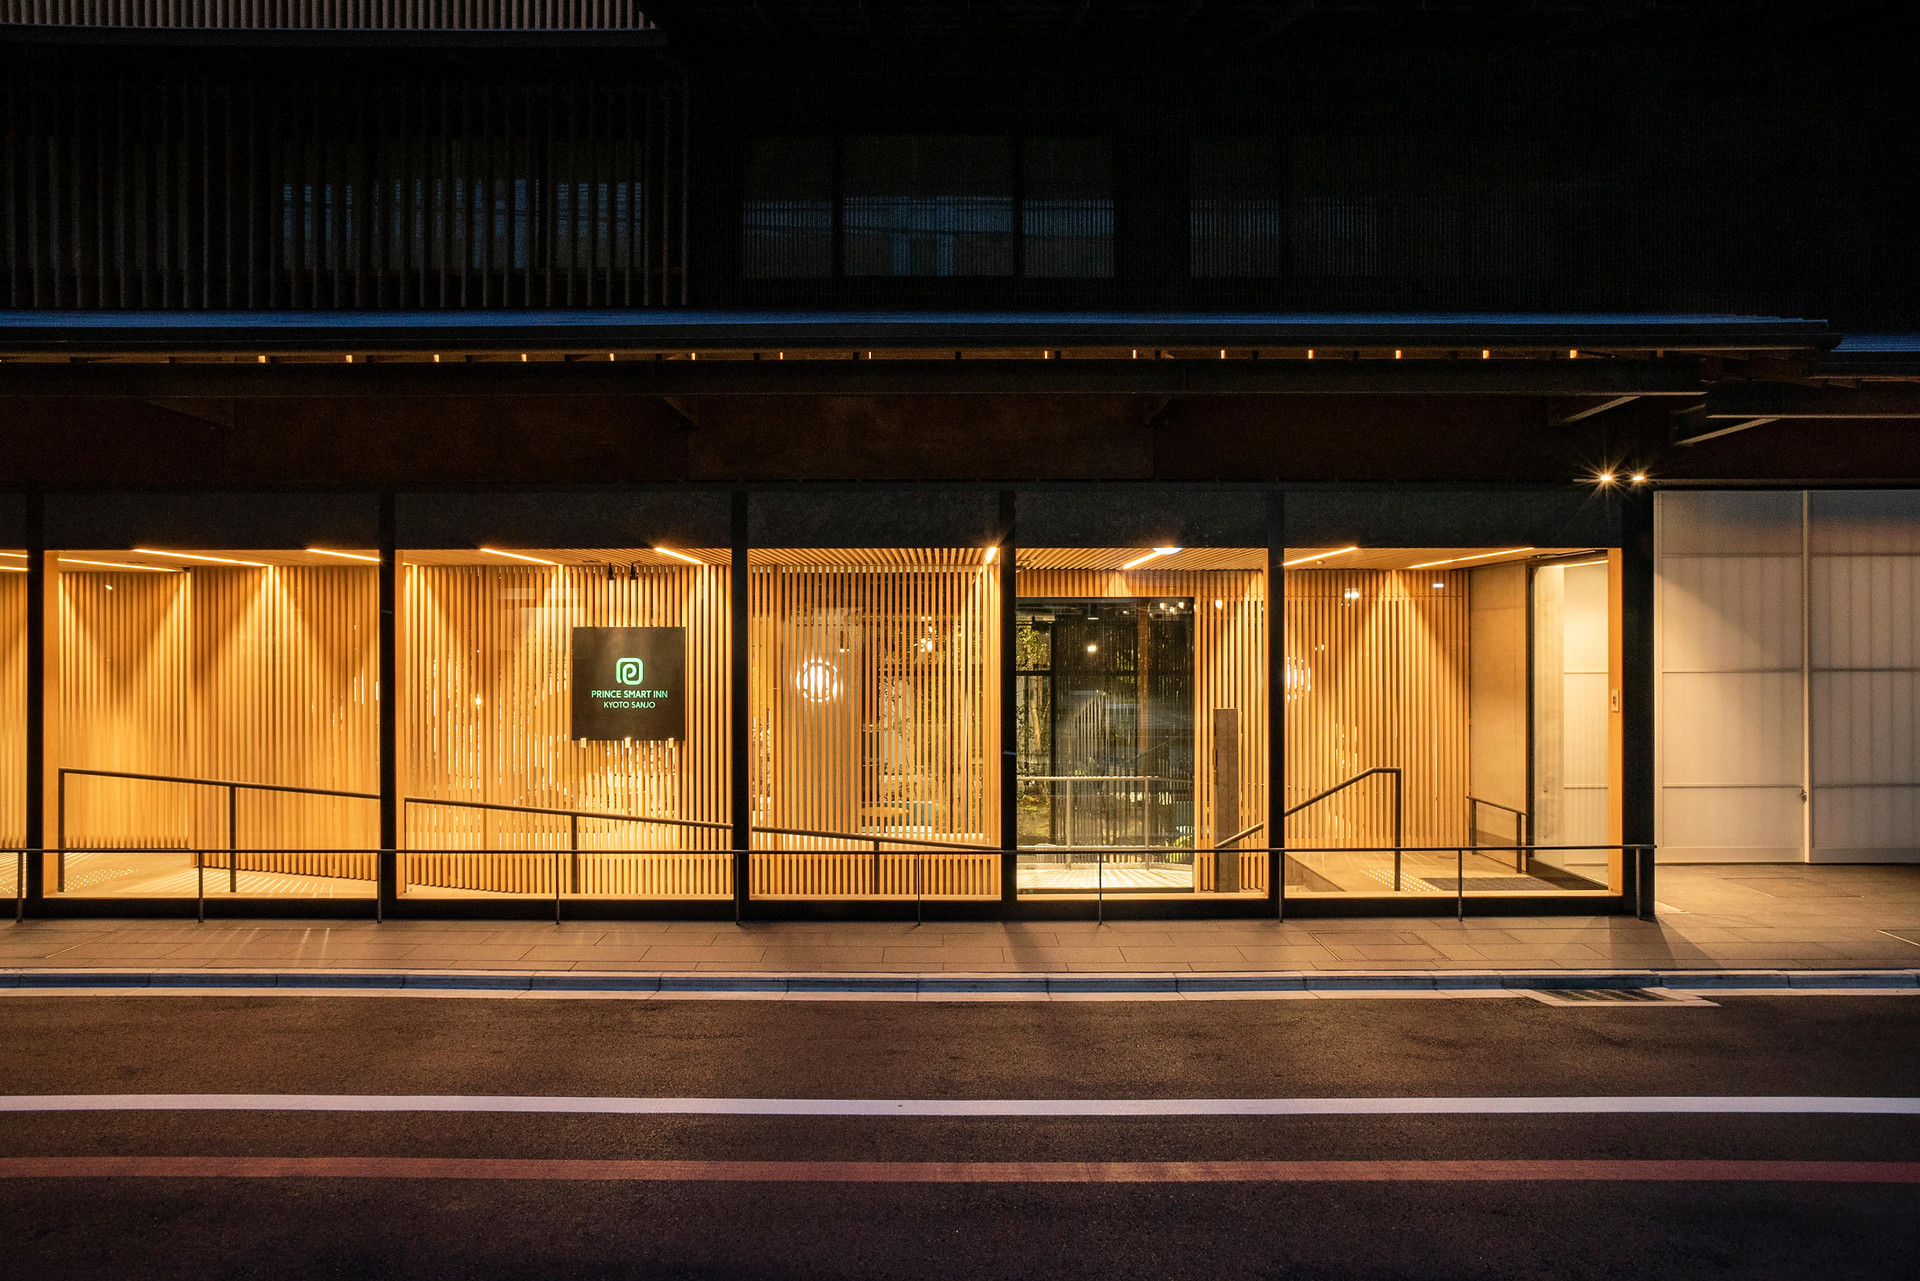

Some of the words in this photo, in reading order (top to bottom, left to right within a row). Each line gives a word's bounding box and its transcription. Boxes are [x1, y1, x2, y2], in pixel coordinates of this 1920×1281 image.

[591, 690, 622, 698] PRINCE
[623, 690, 652, 698] SMART
[653, 690, 668, 698] INN
[603, 701, 630, 709] KYOTO
[631, 701, 656, 709] SANJO
